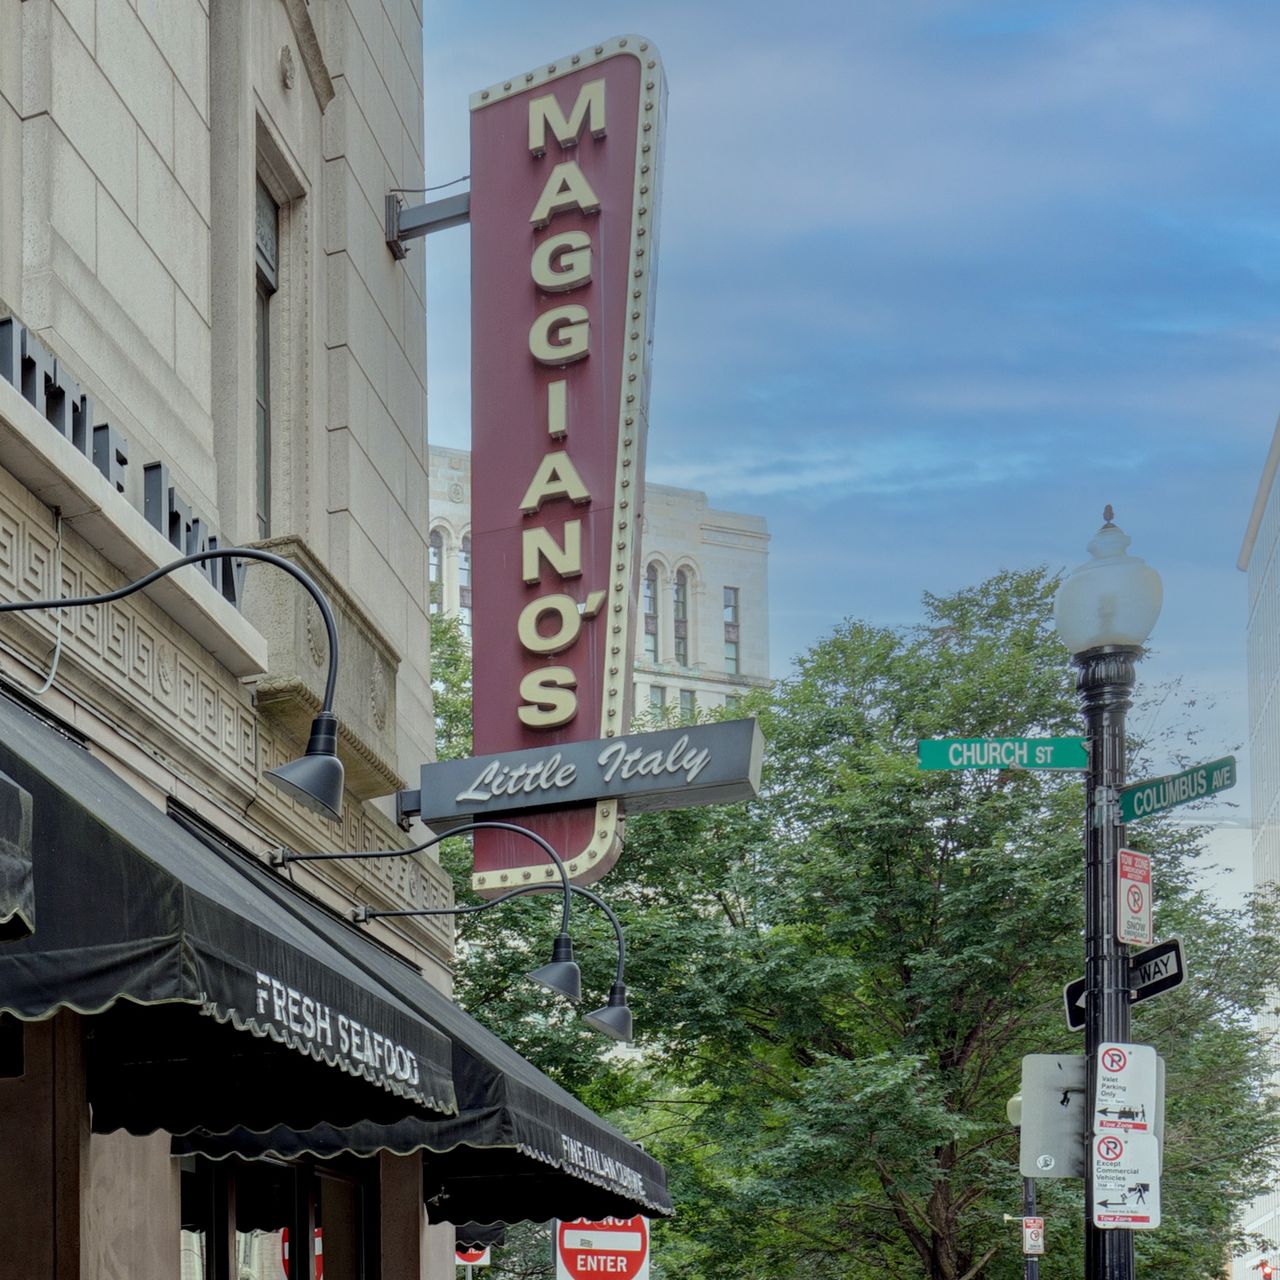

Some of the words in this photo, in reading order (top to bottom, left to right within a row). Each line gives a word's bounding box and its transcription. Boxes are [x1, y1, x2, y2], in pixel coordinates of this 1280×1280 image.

[517, 76, 606, 730] MAGGIANO'S
[456, 752, 576, 801] Little
[597, 734, 712, 783] Italy
[948, 741, 1027, 766] CHURCH
[1035, 746, 1053, 763] ST
[1133, 771, 1207, 815] COLUMBUS
[1212, 767, 1230, 787] AVE
[1126, 920, 1145, 932] SNOW
[1139, 956, 1170, 984] WAY
[256, 971, 333, 1046] FRESH
[338, 1014, 419, 1085] SEAFOOD
[1100, 1090, 1116, 1098] Only
[1101, 1083, 1126, 1092] Parking
[561, 1134, 585, 1168] FINE
[577, 1254, 627, 1273] ENTER
